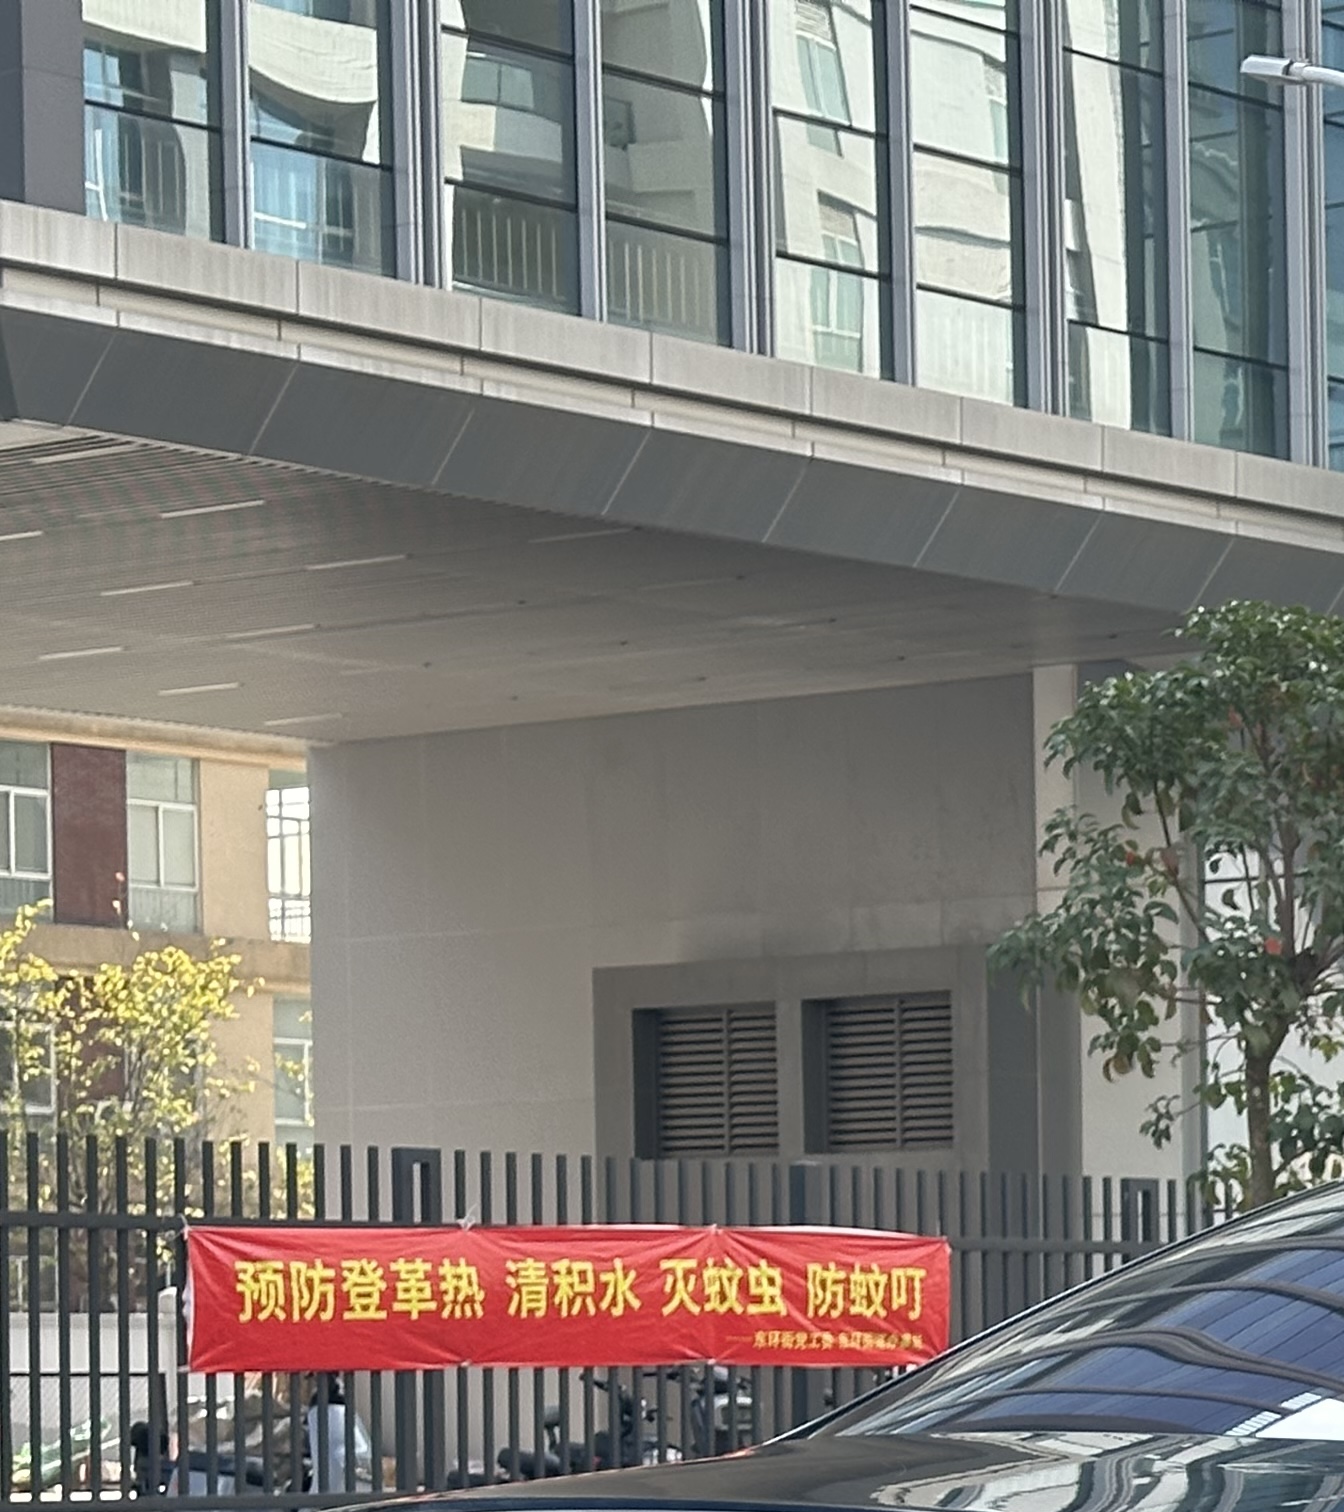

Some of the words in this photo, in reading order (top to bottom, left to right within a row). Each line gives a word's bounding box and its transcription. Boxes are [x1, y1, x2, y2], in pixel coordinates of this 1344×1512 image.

[234, 1257, 486, 1324] 预防登革热
[505, 1257, 643, 1319] 清积水
[659, 1257, 788, 1317] 灭蚊虫
[806, 1261, 927, 1320] 防蚊叮
